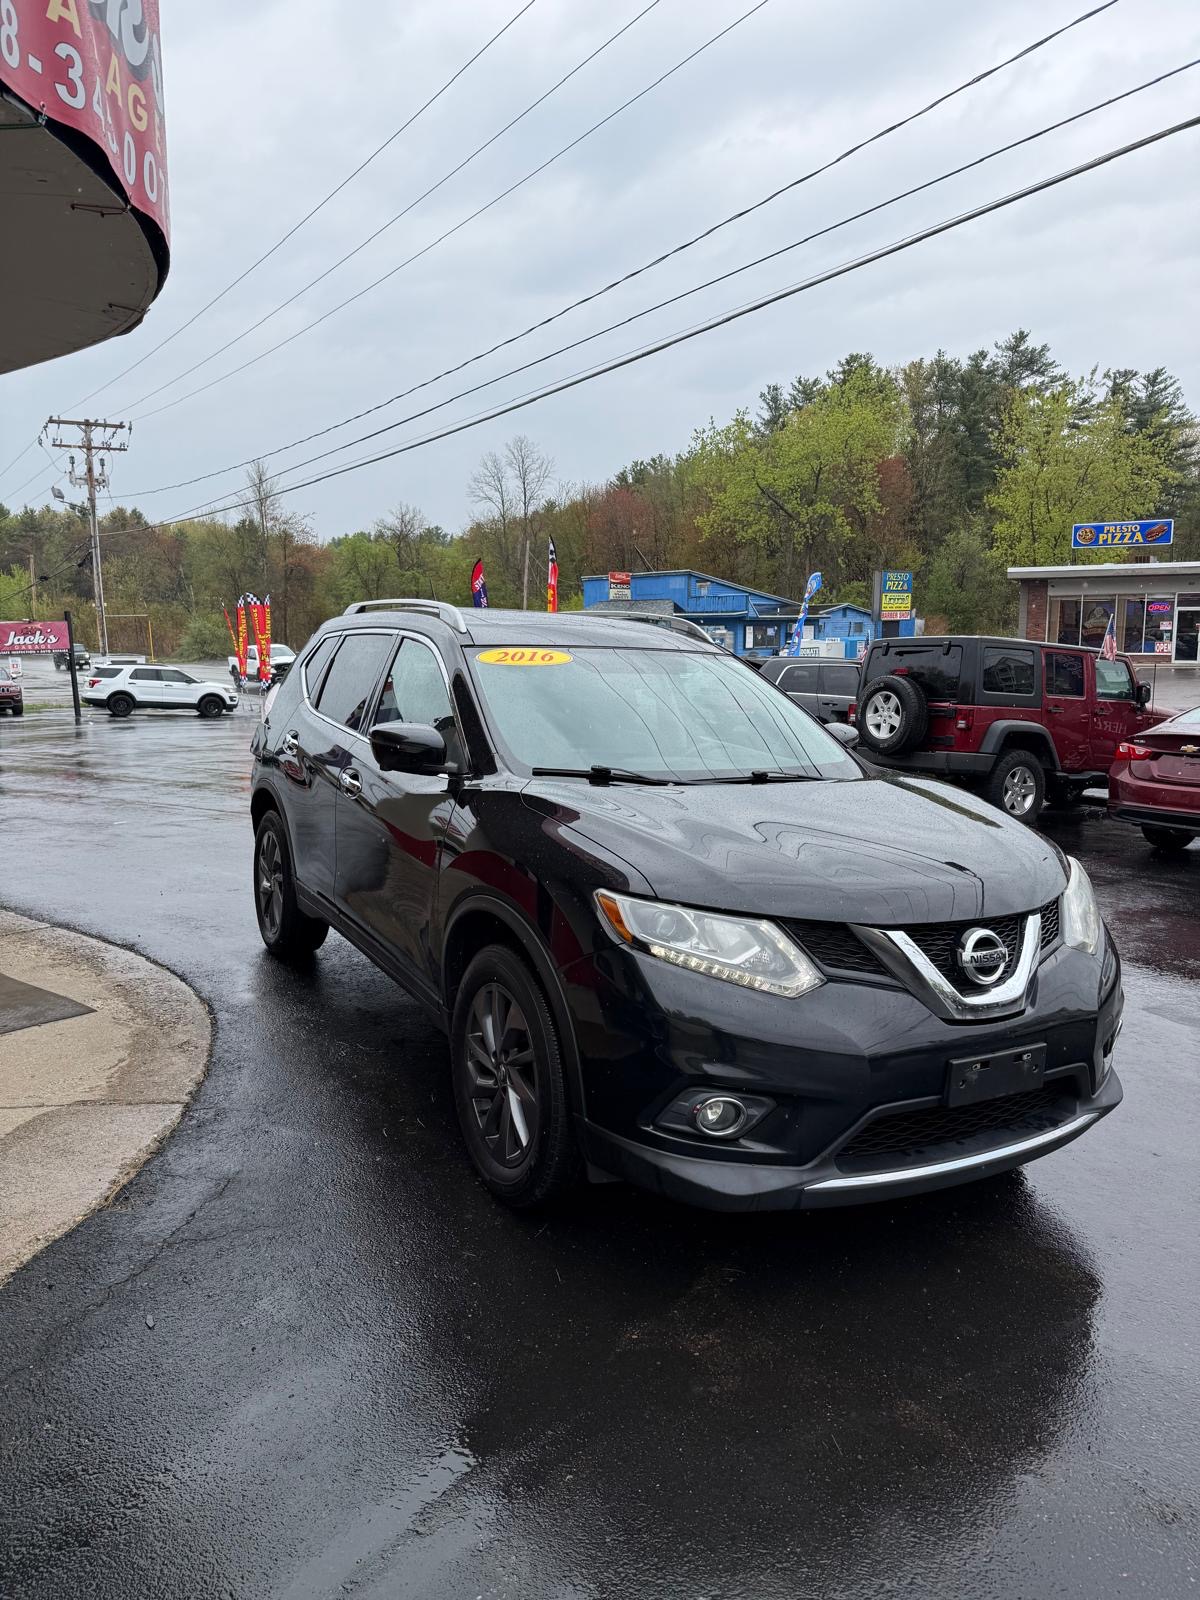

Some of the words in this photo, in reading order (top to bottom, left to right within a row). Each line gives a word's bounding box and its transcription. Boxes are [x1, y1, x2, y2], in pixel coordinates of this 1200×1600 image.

[1104, 525, 1140, 534] PRESTO
[1098, 532, 1144, 545] PIZZA
[886, 572, 910, 581] PRESTO
[1147, 604, 1171, 612] OPEN
[4, 628, 58, 646] Jack's
[1155, 643, 1171, 652] OPEN
[495, 651, 554, 663] 2016
